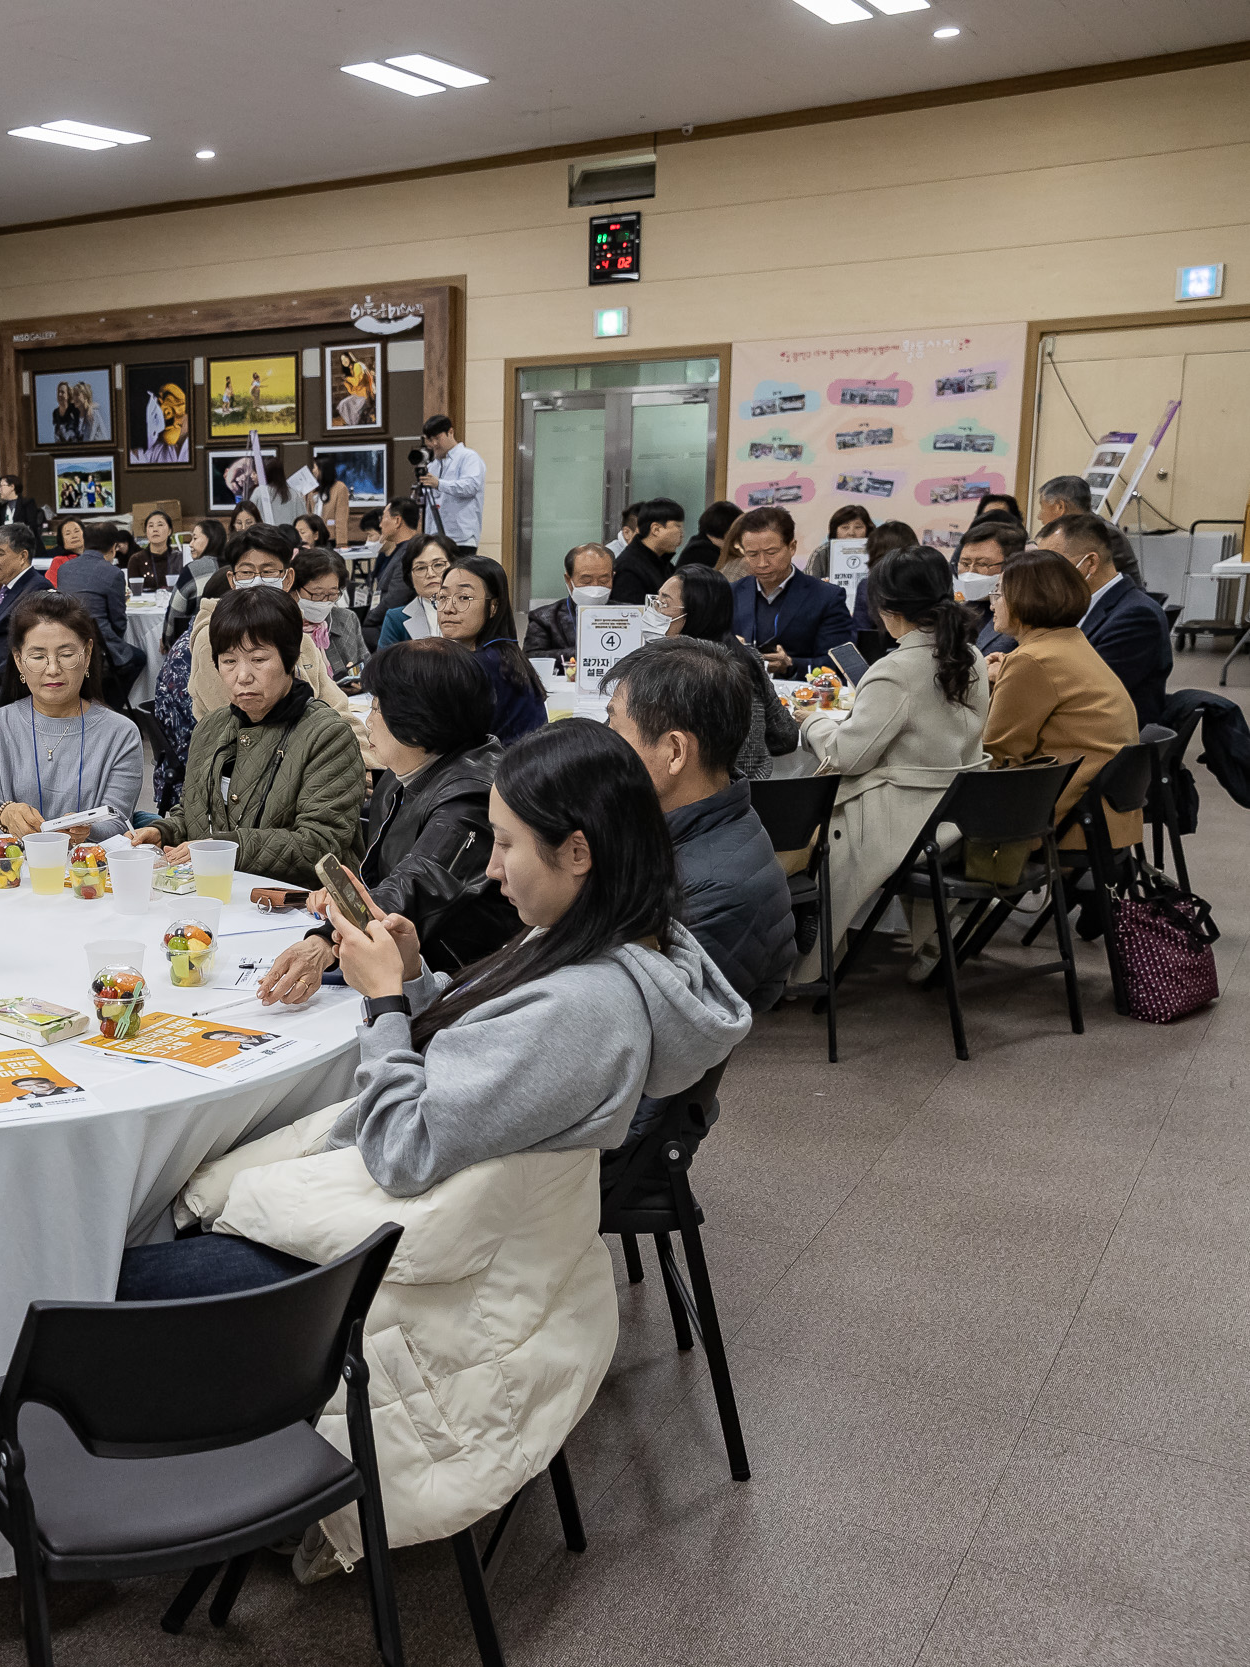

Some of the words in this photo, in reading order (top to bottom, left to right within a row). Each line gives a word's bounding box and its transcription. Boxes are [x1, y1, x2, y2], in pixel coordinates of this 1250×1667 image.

[617, 256, 632, 269] 02
[606, 636, 615, 647] 4
[583, 658, 609, 667] 참가자
[587, 668, 604, 677] 설문
[6, 1060, 42, 1070] 만든
